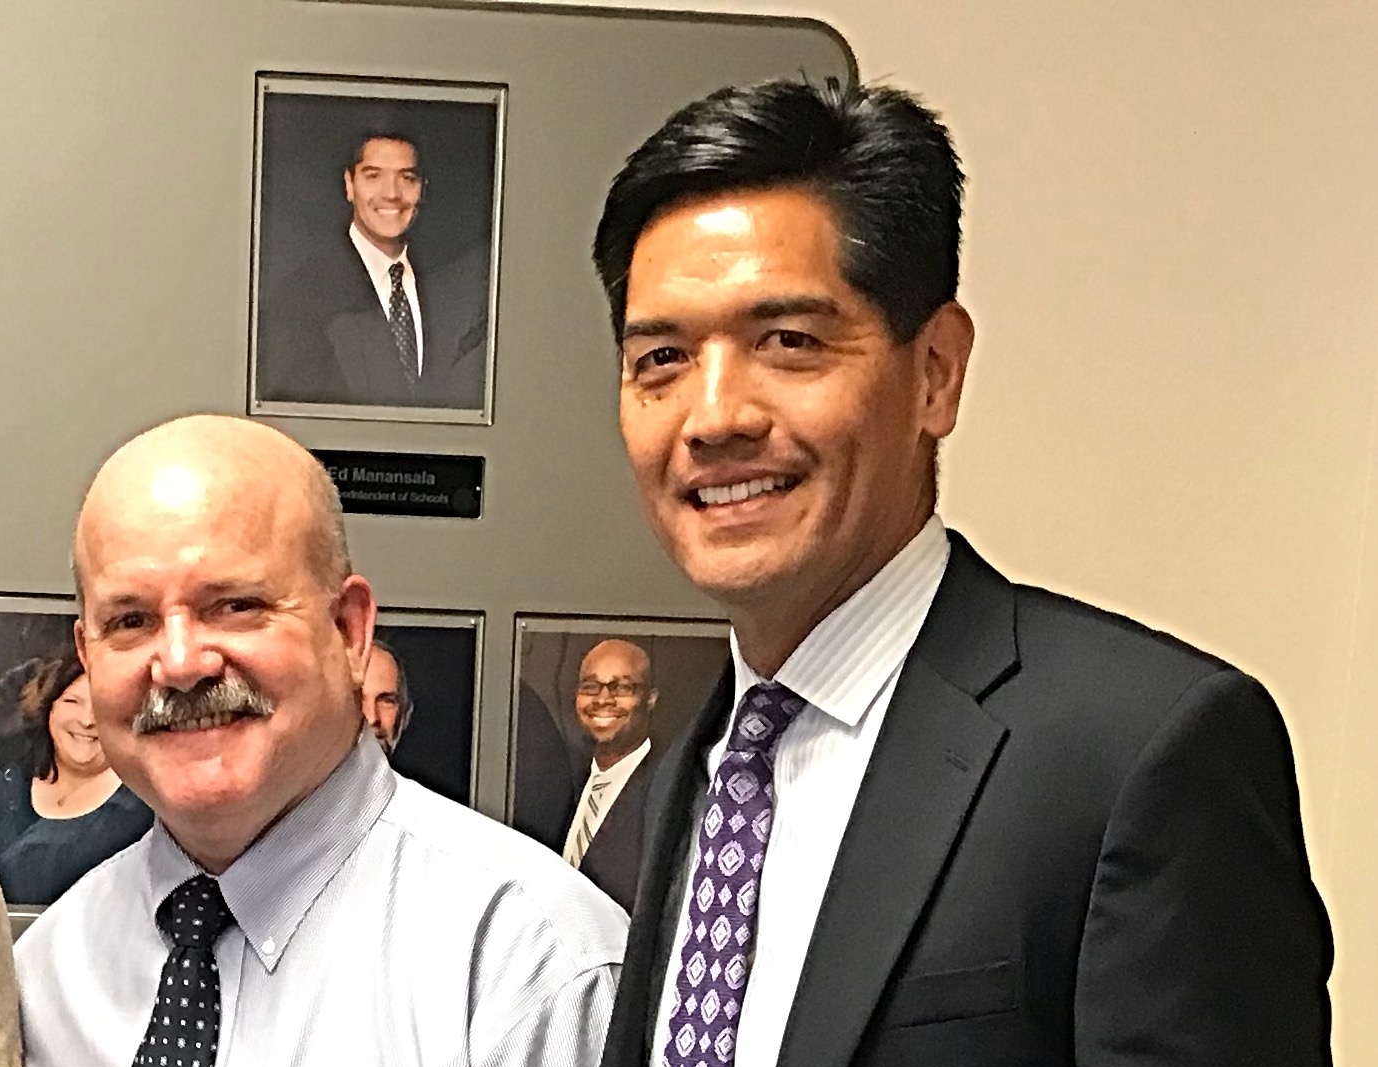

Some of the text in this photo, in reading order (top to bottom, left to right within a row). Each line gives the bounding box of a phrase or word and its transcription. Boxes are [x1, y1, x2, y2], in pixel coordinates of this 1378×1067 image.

[327, 466, 436, 486] Ed Manansala
[410, 492, 449, 504] Schools
